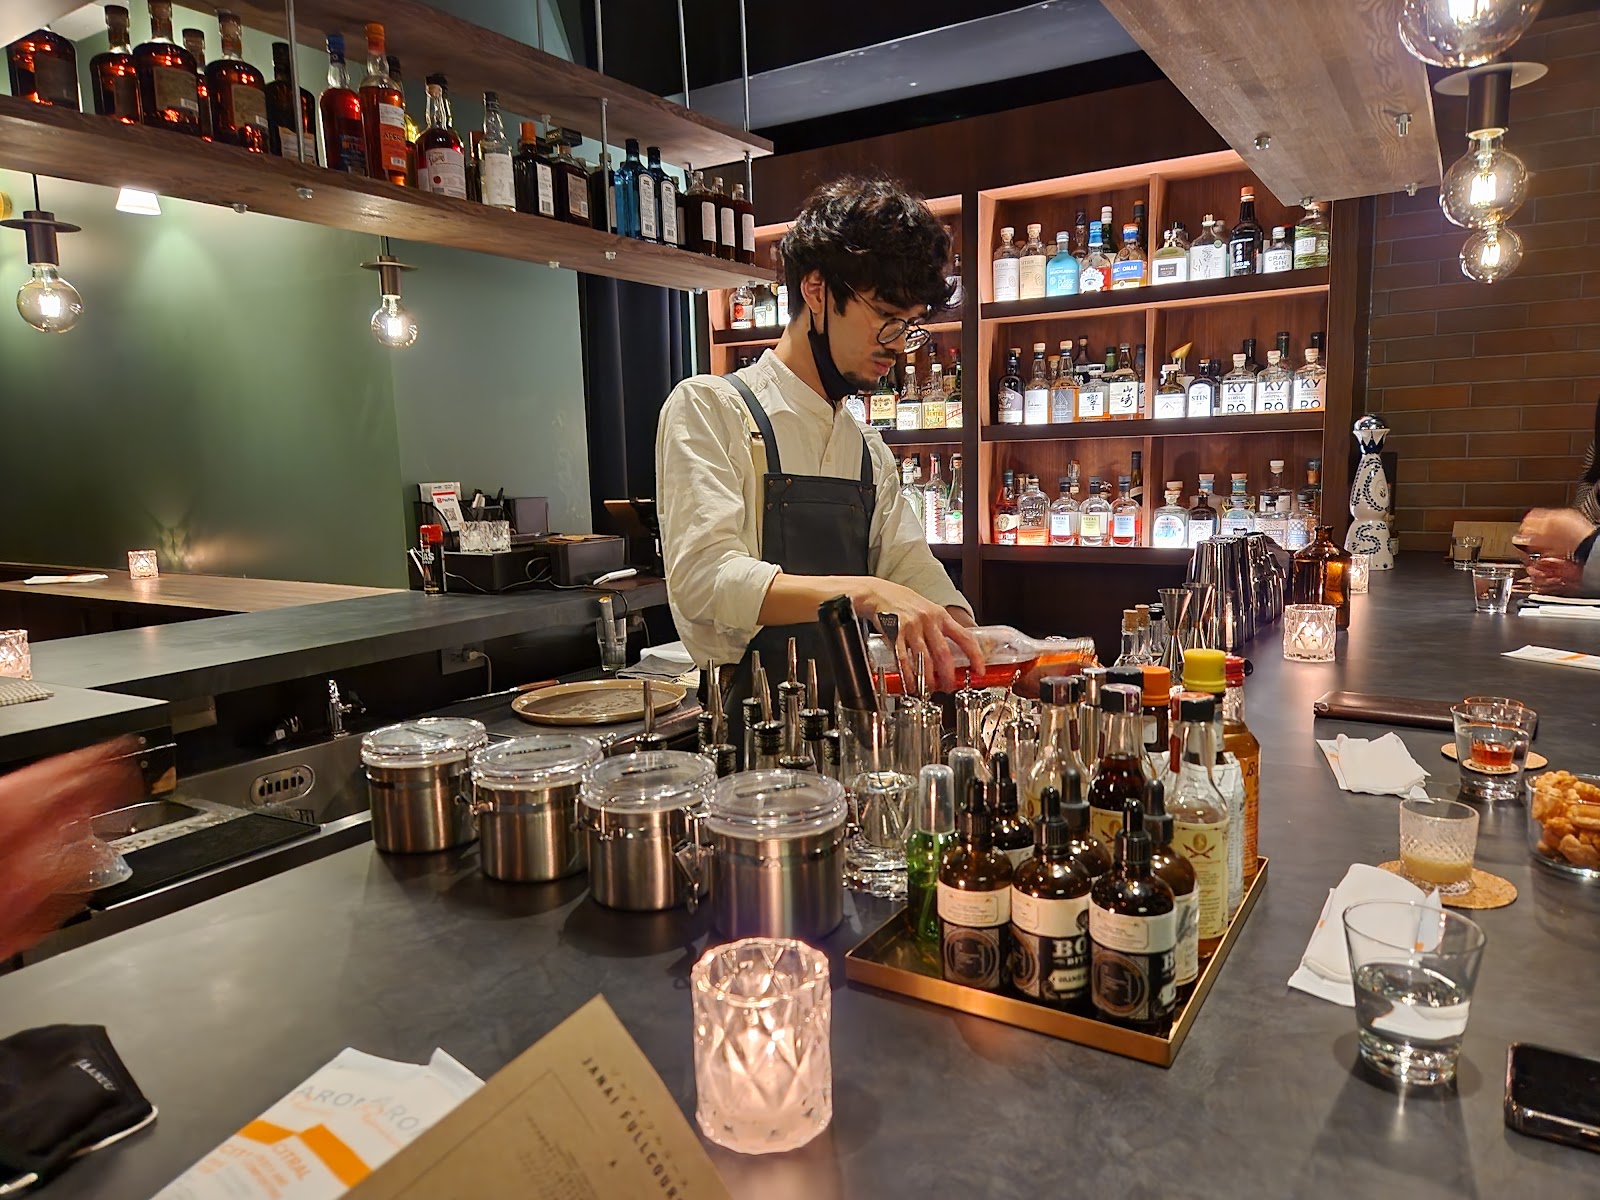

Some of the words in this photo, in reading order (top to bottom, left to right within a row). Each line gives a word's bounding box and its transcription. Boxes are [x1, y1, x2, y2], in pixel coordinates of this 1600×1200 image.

[1228, 382, 1247, 393] KY
[1265, 381, 1284, 392] KY
[1301, 379, 1321, 389] KY
[619, 1109, 683, 1200] FULLCOUR
